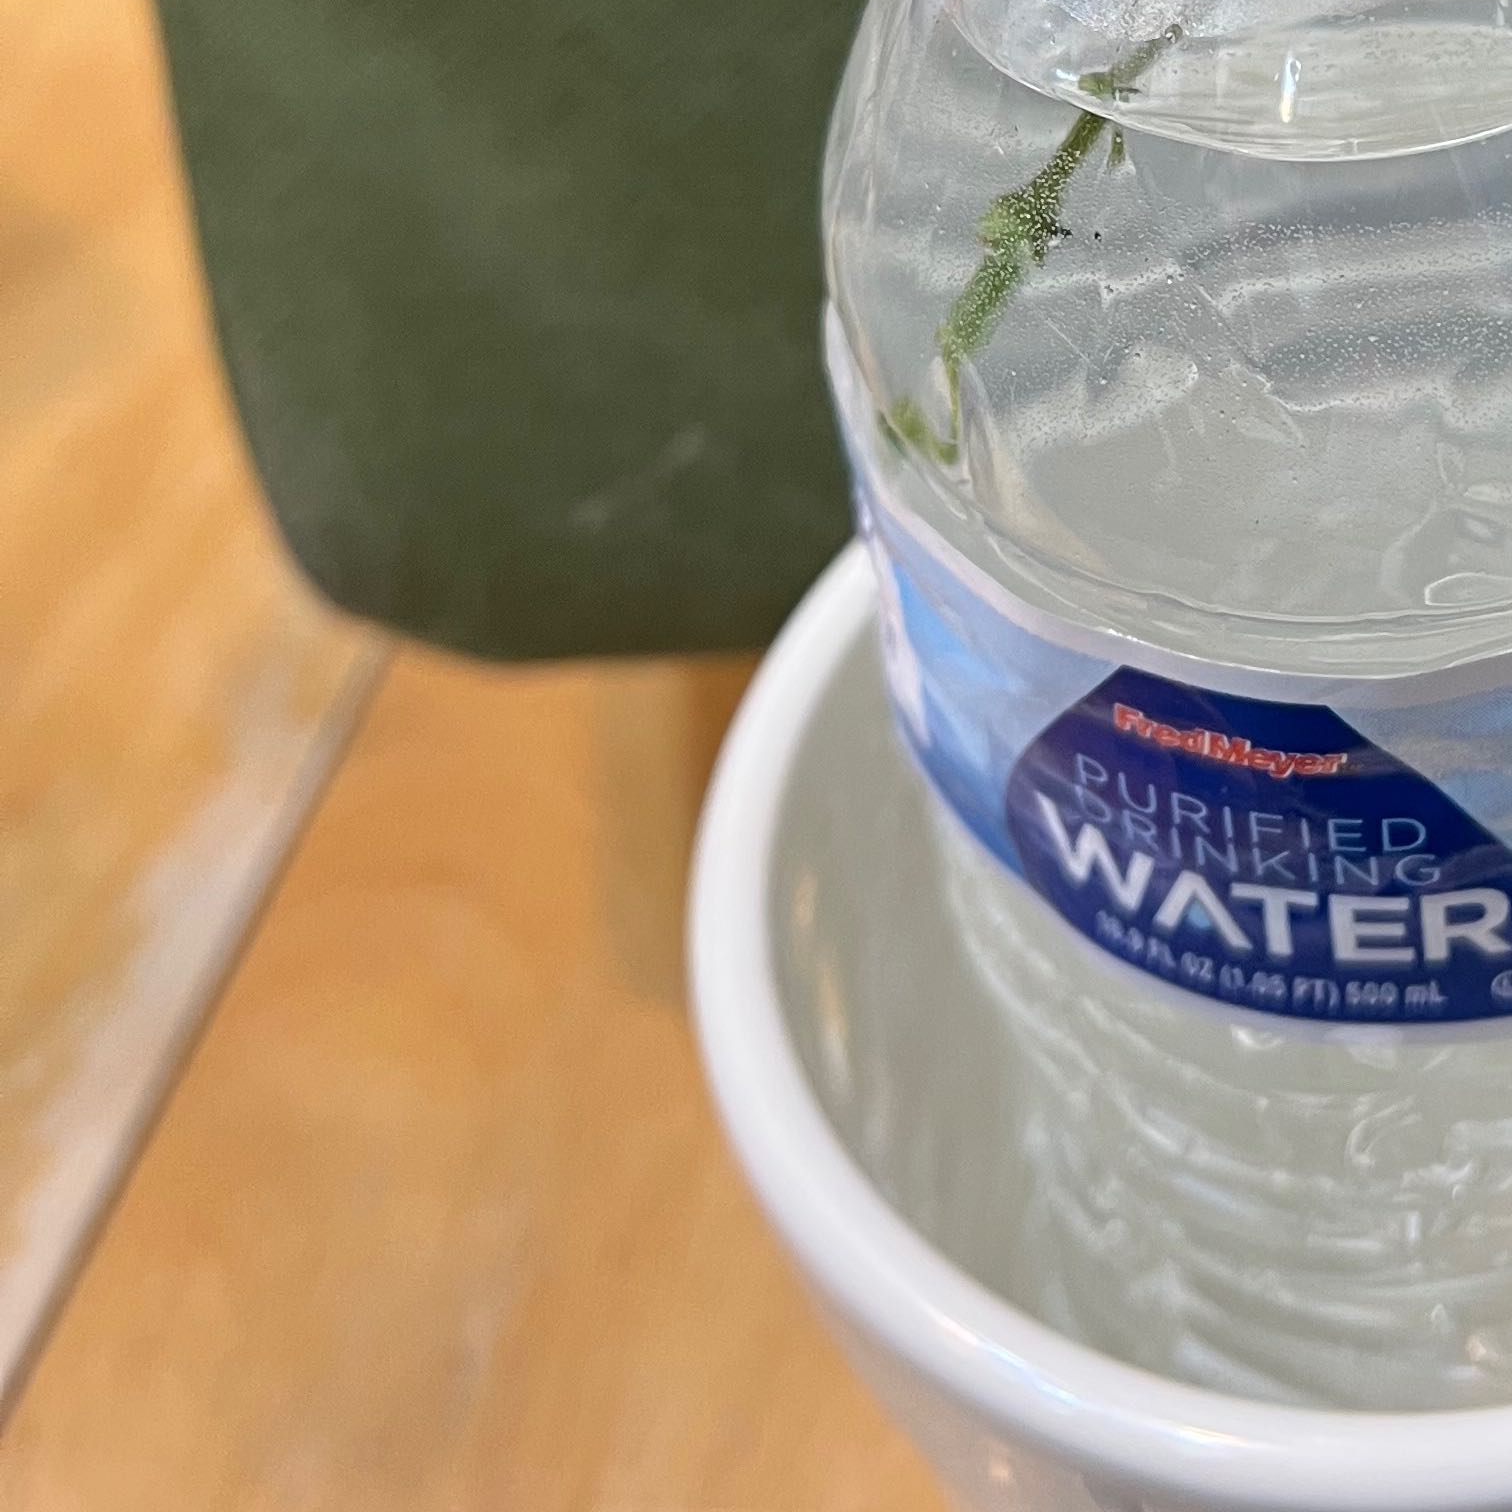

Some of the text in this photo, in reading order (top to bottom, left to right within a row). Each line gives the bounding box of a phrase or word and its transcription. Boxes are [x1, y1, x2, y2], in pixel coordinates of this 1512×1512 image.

[1074, 753, 1427, 853] PURIFIED
[1074, 785, 1441, 887] DRINKING
[1181, 951, 1214, 982] OZ
